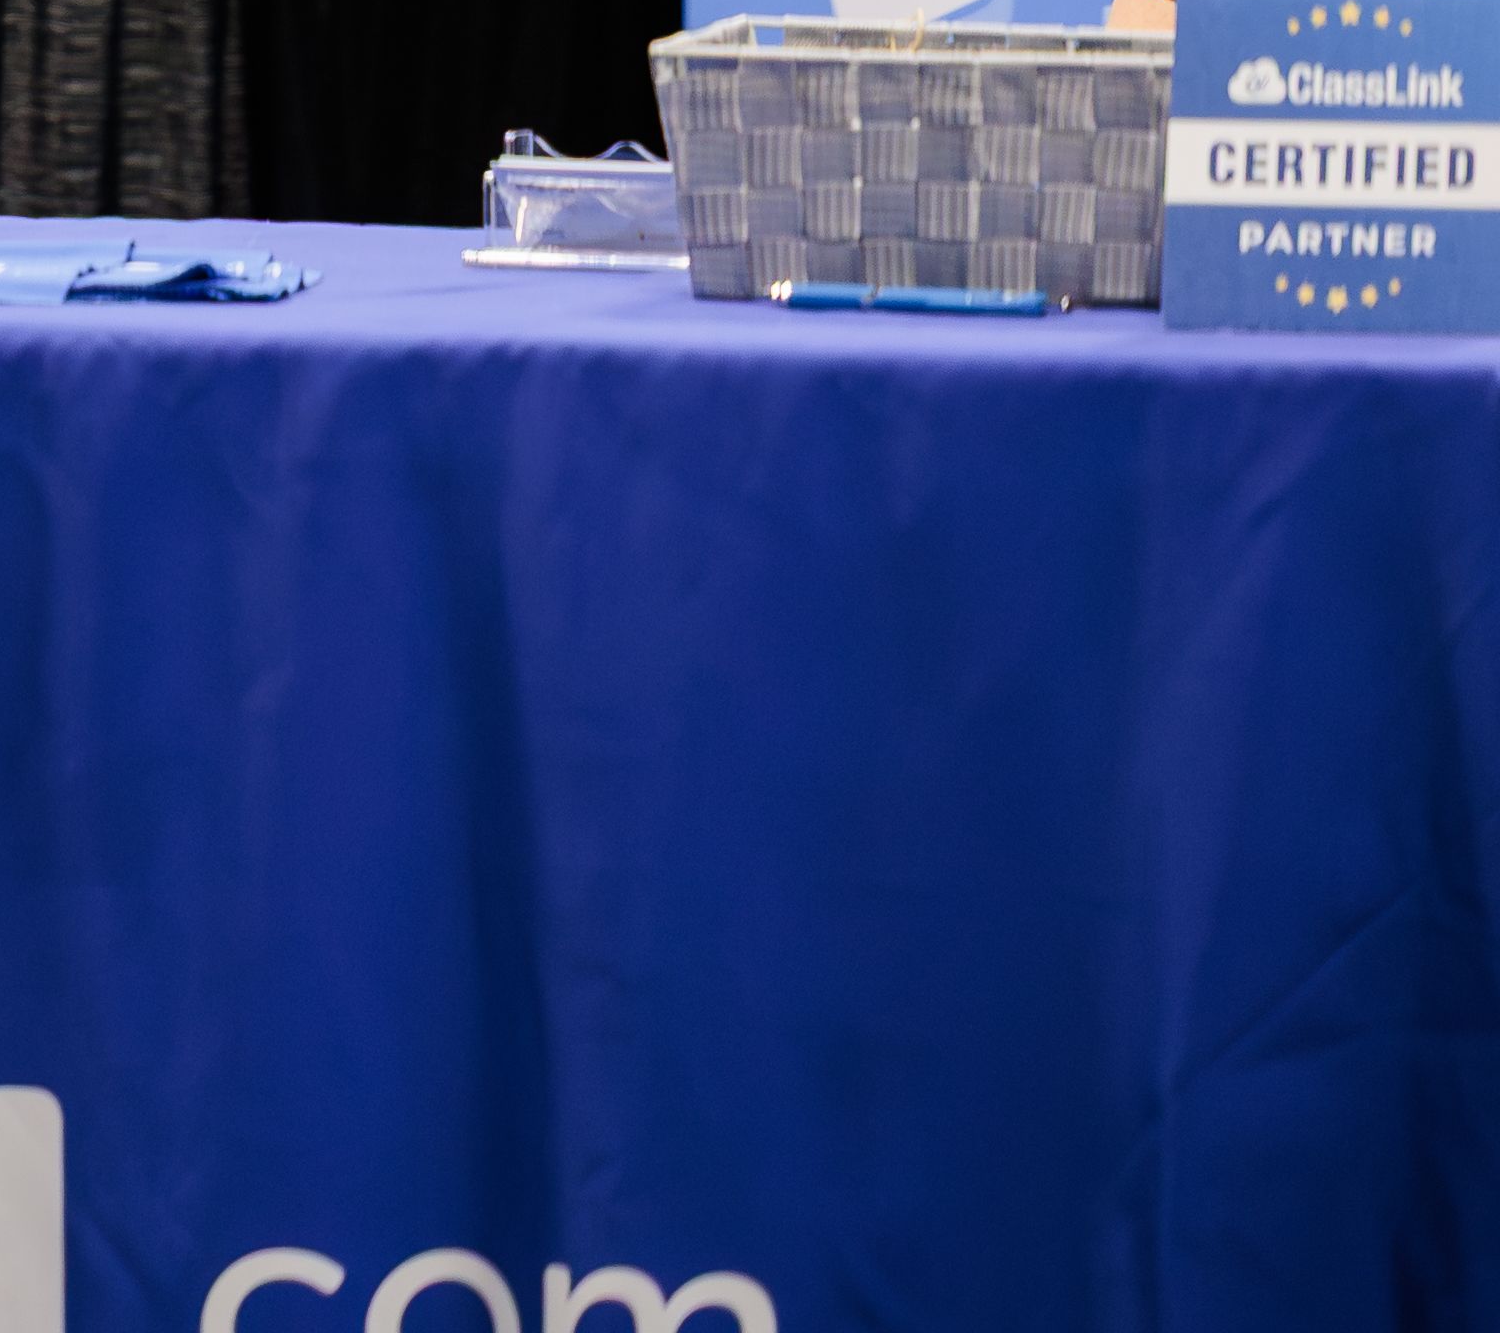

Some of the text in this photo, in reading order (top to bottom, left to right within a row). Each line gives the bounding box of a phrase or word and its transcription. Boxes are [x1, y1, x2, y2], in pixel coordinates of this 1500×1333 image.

[1287, 60, 1465, 109] ClassLink
[1208, 140, 1476, 190] CERTIFIED
[1238, 219, 1438, 258] PARTNER
